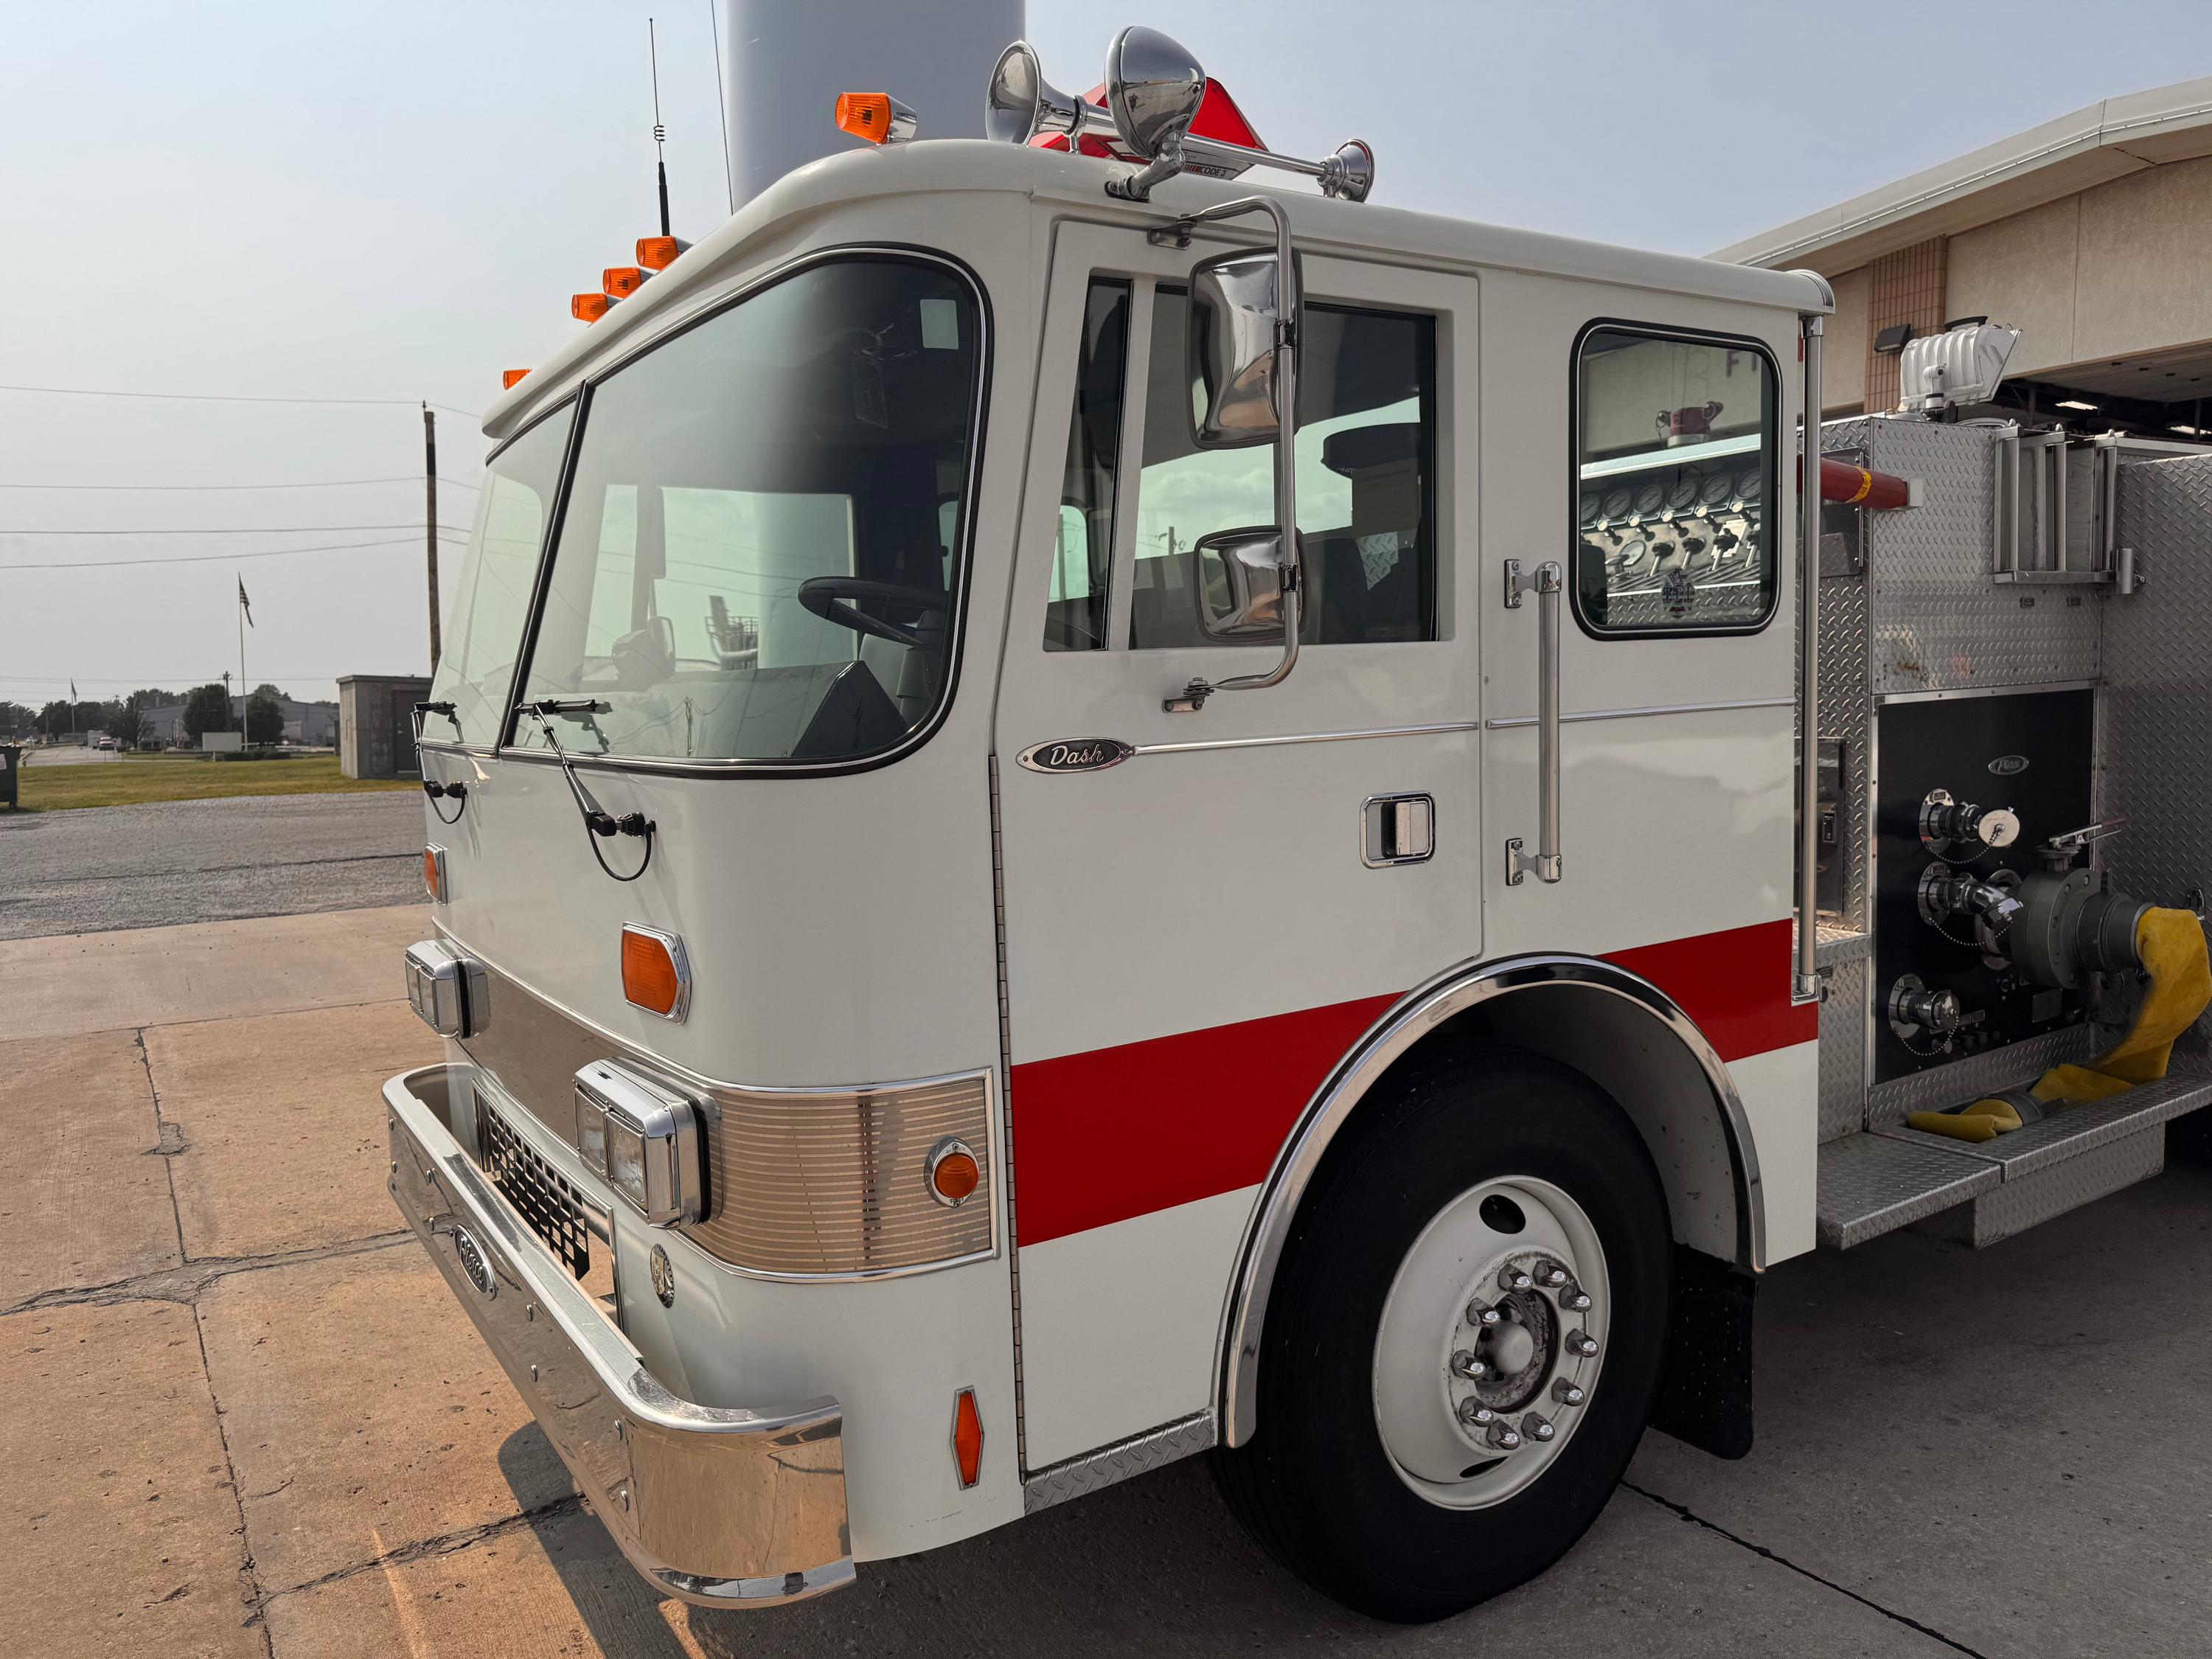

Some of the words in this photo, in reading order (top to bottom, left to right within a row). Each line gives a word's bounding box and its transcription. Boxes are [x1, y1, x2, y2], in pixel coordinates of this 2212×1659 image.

[1200, 167, 1221, 176] CODE
[1050, 744, 1104, 765] Dash
[459, 1234, 484, 1284] Pierce
